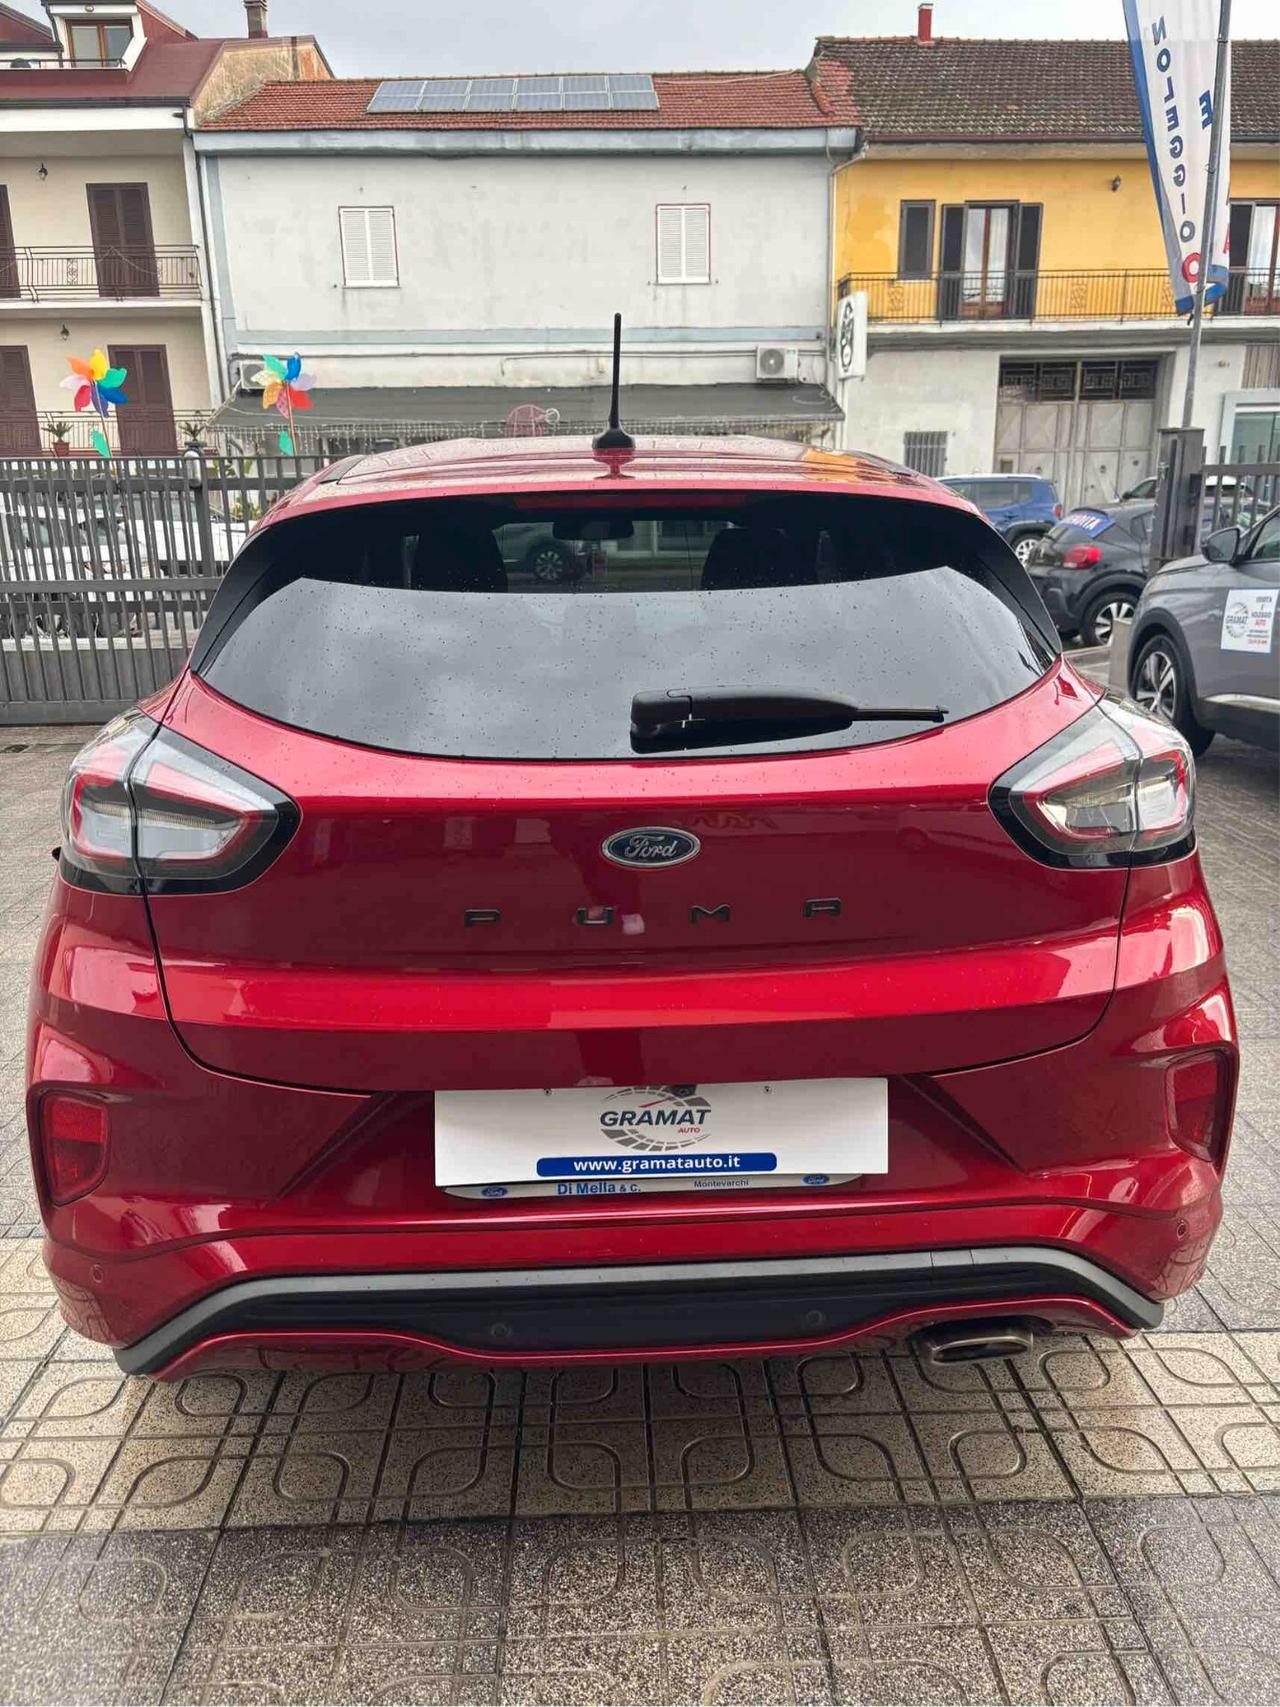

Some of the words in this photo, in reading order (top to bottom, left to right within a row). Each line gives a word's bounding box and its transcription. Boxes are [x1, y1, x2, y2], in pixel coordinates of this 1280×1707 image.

[625, 834, 679, 858] Ford
[464, 896, 842, 927] PUMA
[600, 1109, 712, 1127] GRAMAT
[573, 1156, 741, 1173] www.gramatauto.it
[557, 1183, 572, 1195] Di
[694, 1179, 749, 1188] Montevarchi
